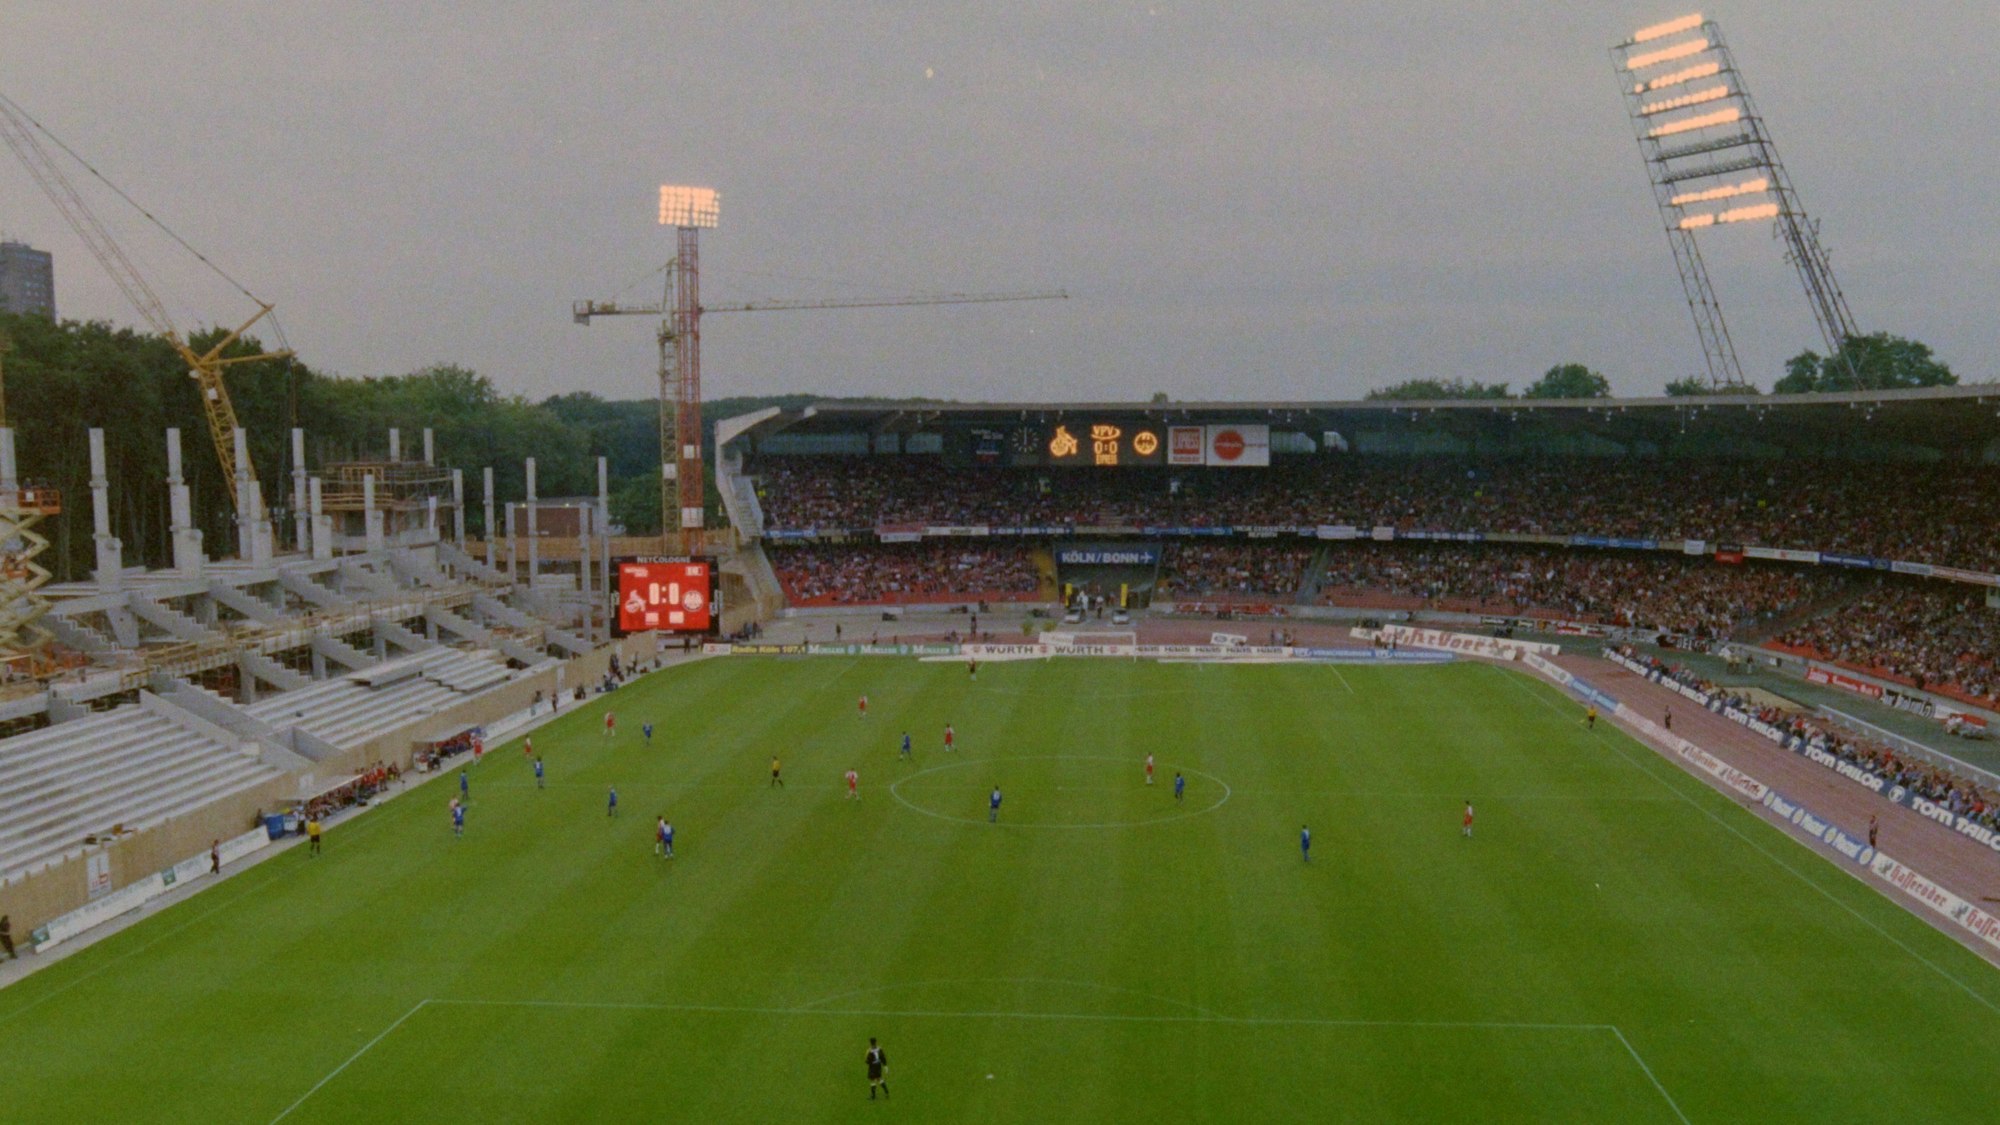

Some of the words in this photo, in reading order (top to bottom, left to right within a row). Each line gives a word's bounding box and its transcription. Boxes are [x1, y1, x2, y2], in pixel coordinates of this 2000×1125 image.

[1094, 441, 1118, 455] 0:0
[1723, 706, 1749, 726] TOM
[1748, 719, 1784, 746] TAILOR
[1805, 746, 1836, 769] TOM
[1836, 759, 1884, 793] TAILOR
[1912, 796, 1954, 827] TOM
